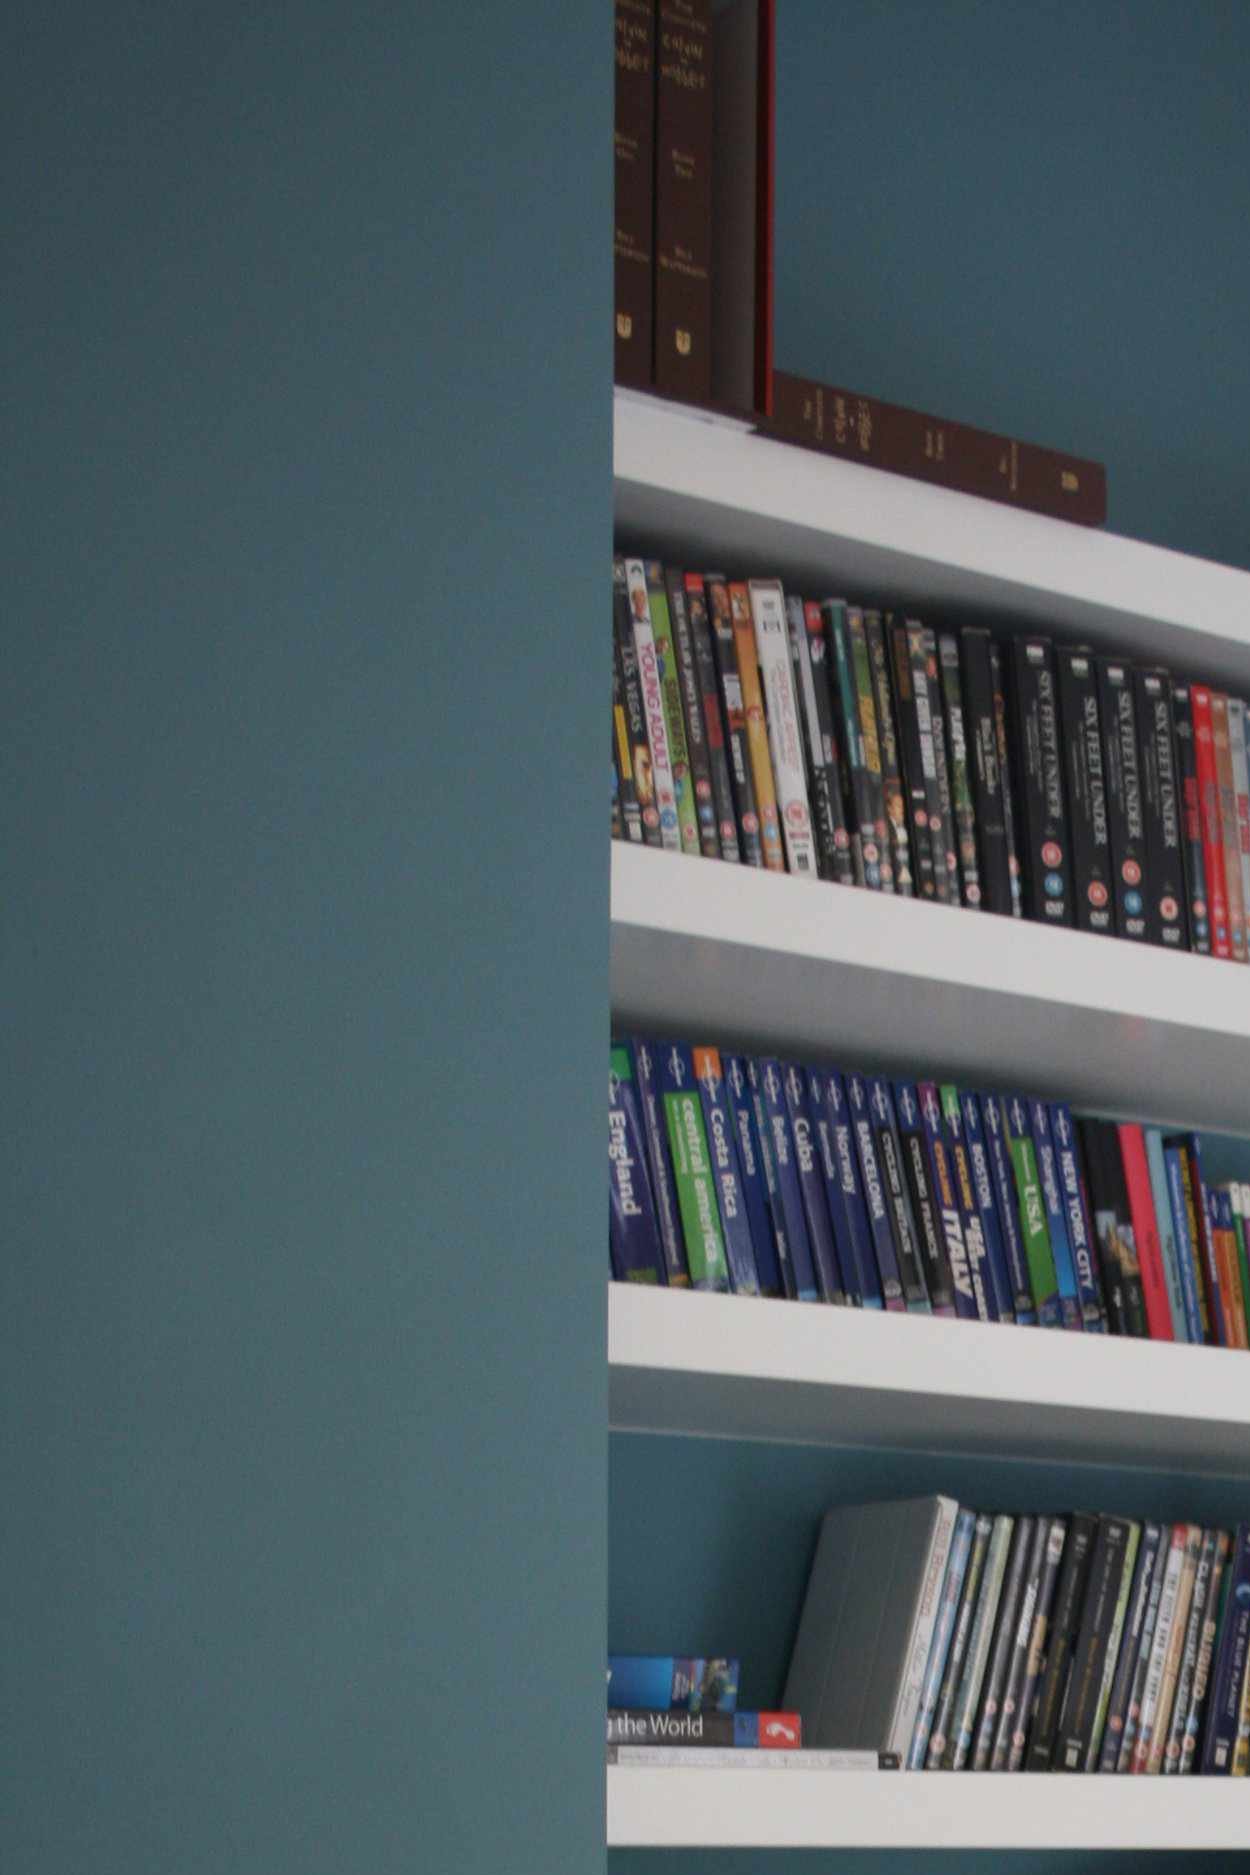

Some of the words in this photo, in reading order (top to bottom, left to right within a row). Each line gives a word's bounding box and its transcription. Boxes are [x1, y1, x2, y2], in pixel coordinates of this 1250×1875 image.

[619, 644, 638, 678] LAS
[637, 641, 665, 715] YOUNG
[1038, 670, 1053, 699] SIX
[624, 681, 645, 734] VEGAS
[1040, 704, 1058, 751] FEET
[1082, 696, 1098, 729] SIX
[1116, 690, 1132, 723] SIX
[1153, 701, 1170, 732] SIX
[647, 713, 673, 772] ADULT
[1084, 730, 1103, 777] FEET
[1118, 725, 1137, 773] FEET
[1154, 735, 1174, 781] FEET
[1041, 754, 1065, 820] UNDER
[1087, 780, 1109, 846] UNDER
[1121, 775, 1143, 841] UNDER
[1158, 784, 1181, 848] UNDER
[679, 1096, 707, 1174] central
[708, 1107, 733, 1168] Costa
[736, 1108, 758, 1177] Panama
[771, 1114, 791, 1166] Belize
[792, 1116, 816, 1173] Cuba
[832, 1124, 858, 1196] Norway
[608, 1111, 642, 1217] England
[856, 1119, 885, 1220] BARCELONA
[933, 1140, 954, 1208] CYCLING
[954, 1144, 974, 1211] CYCLING
[971, 1142, 993, 1210] BOSTON
[1037, 1144, 1063, 1216] Shanghai
[1060, 1149, 1079, 1195] NEW
[692, 1176, 720, 1264] america
[719, 1172, 741, 1219] Rica
[881, 1131, 901, 1194] CYCLING
[893, 1196, 912, 1255] BRITAIN
[908, 1136, 928, 1199] CYCLING
[920, 1199, 939, 1260] FRANCE
[1022, 1183, 1044, 1236] USA
[1067, 1196, 1087, 1247] YORK
[941, 1207, 973, 1301] ITALY
[1075, 1248, 1094, 1291] CITY
[1237, 1609, 1250, 1635] THE
[1231, 1636, 1246, 1666] BLUE
[1224, 1670, 1243, 1719] PLANET
[617, 1712, 647, 1734] the
[650, 1714, 704, 1736] World
